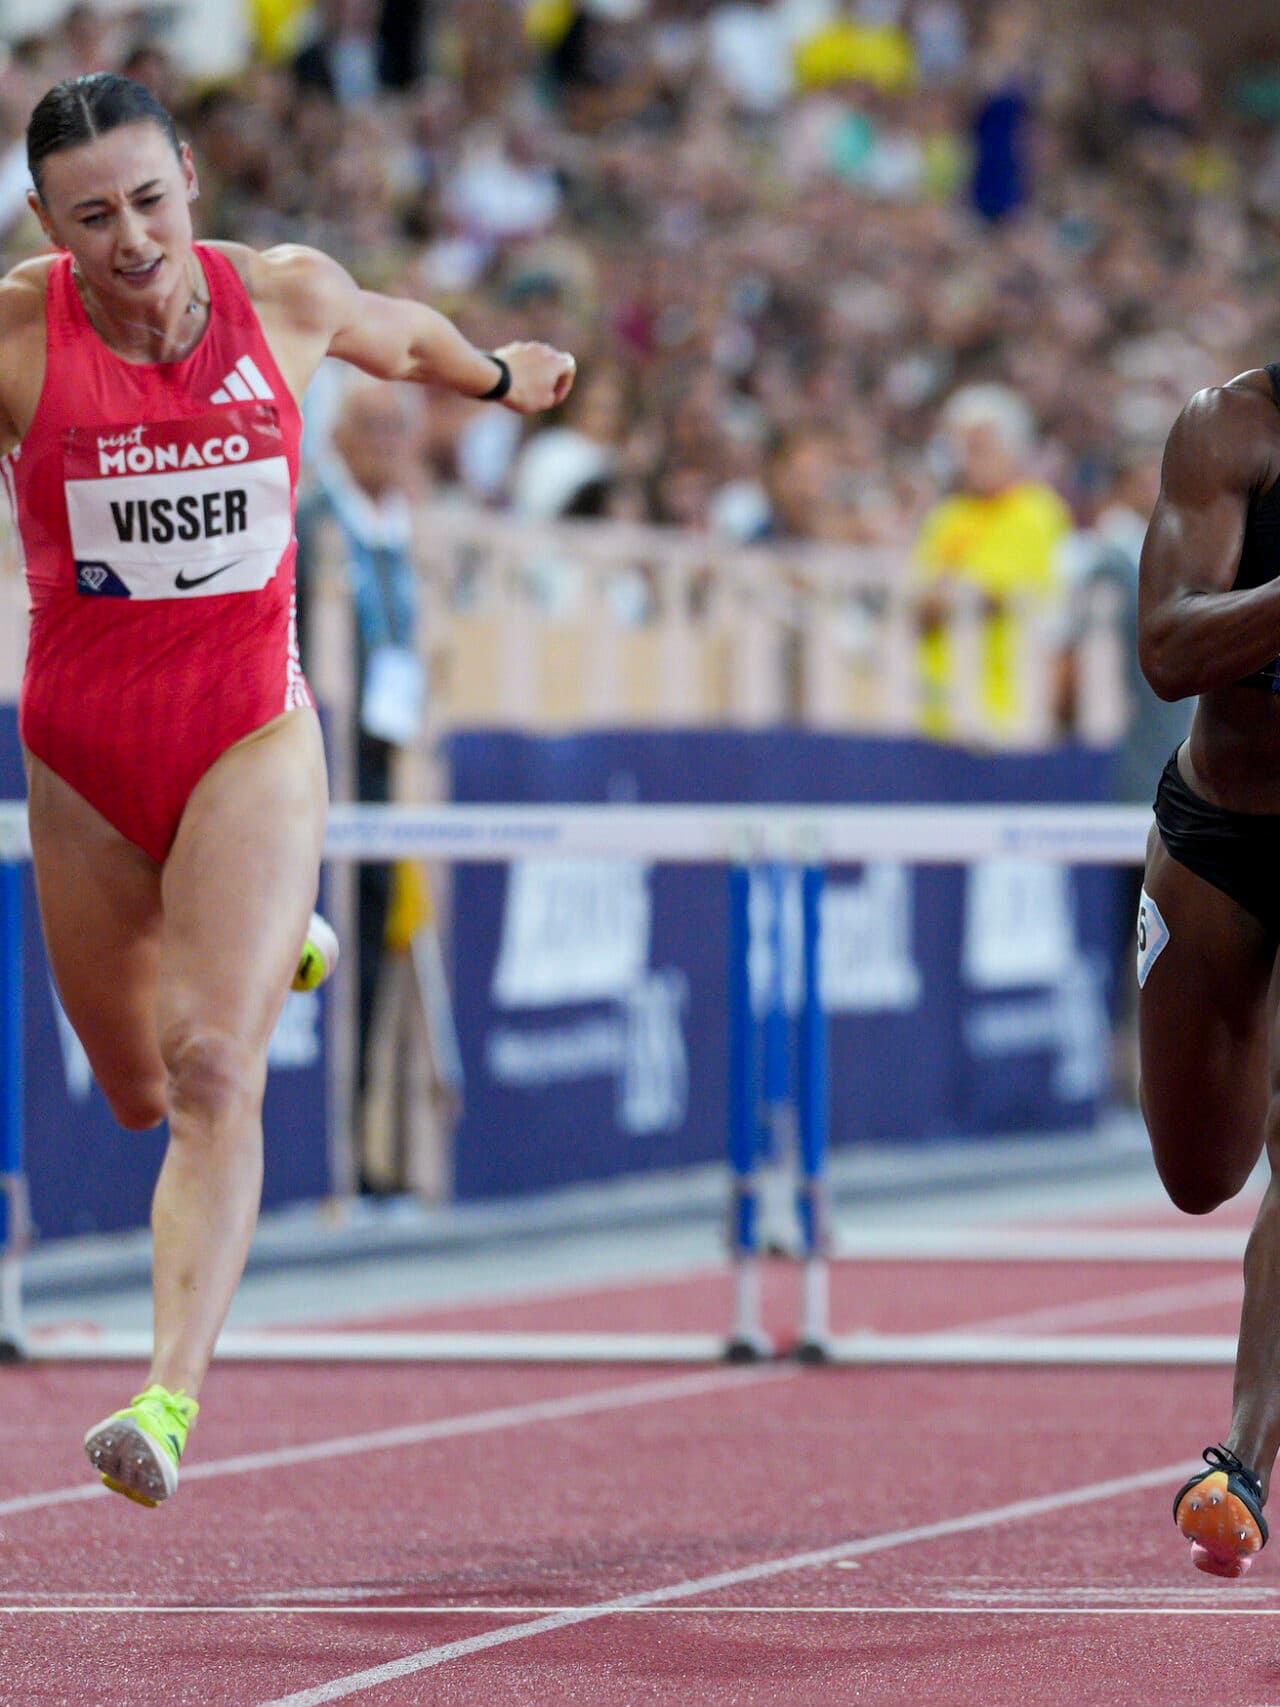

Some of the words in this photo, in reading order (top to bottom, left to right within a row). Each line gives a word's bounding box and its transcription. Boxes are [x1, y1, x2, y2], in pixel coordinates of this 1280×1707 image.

[97, 424, 148, 449] visit
[100, 435, 249, 475] MONACO
[110, 489, 247, 543] VISSER
